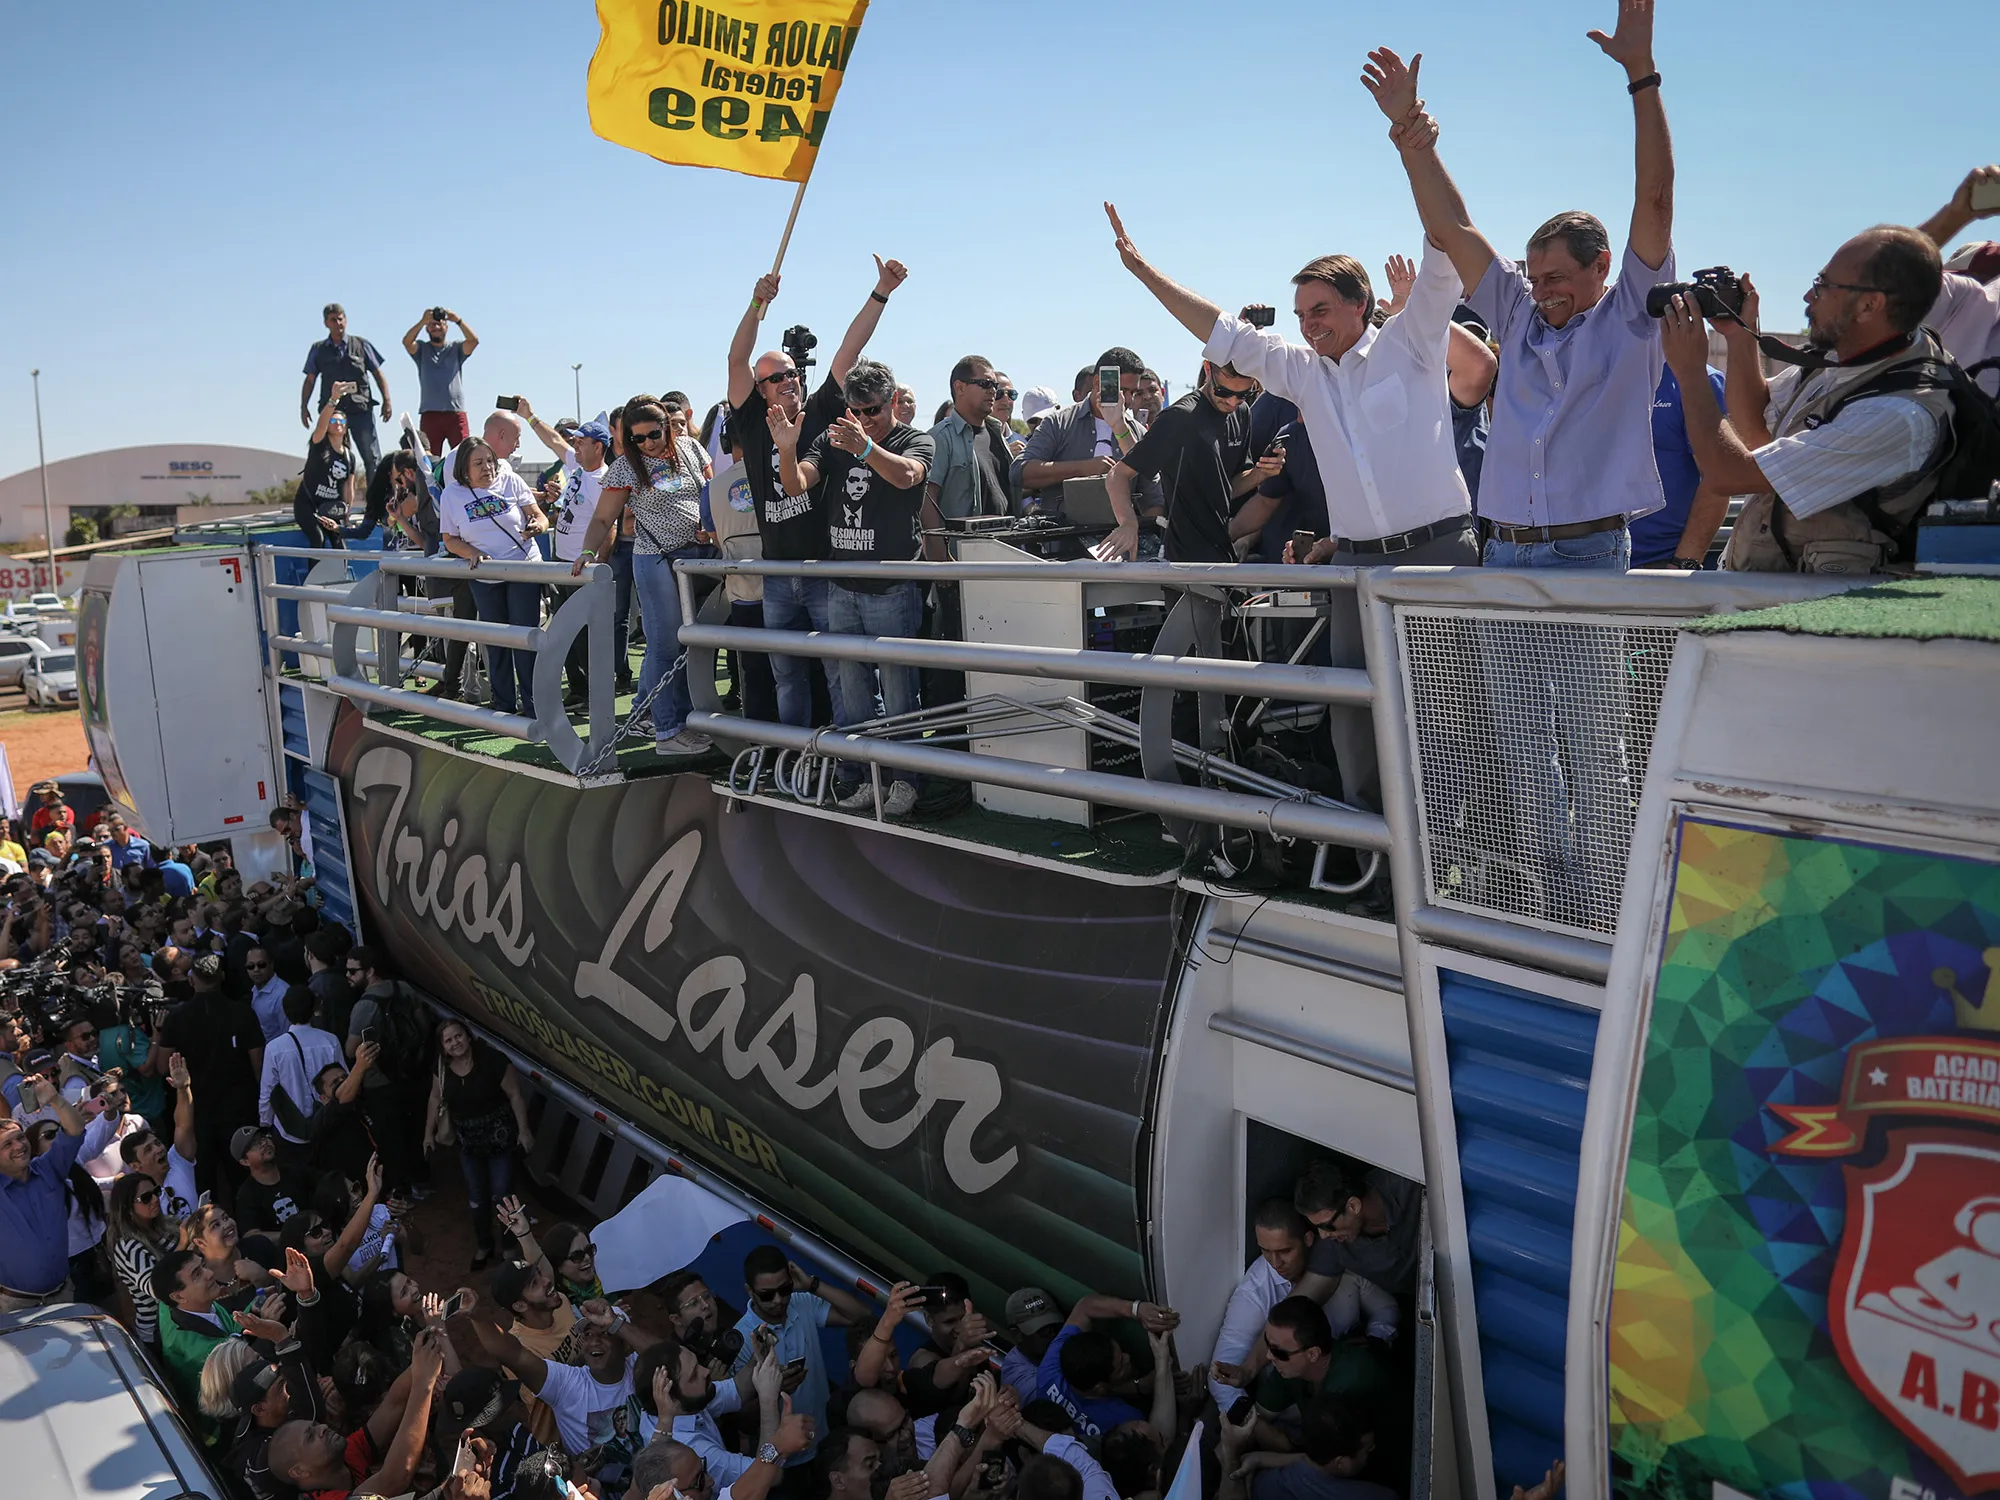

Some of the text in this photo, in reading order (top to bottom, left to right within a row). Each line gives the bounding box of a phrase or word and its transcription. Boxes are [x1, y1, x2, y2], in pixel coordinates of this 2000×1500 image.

[169, 461, 213, 471] SESC
[354, 746, 1019, 1195] Trios Laser
[472, 978, 793, 1186] TRIOSLASER.COM.BR
[1934, 1054, 2000, 1084] ACAD
[1046, 1383, 1101, 1436] RUBÃO
